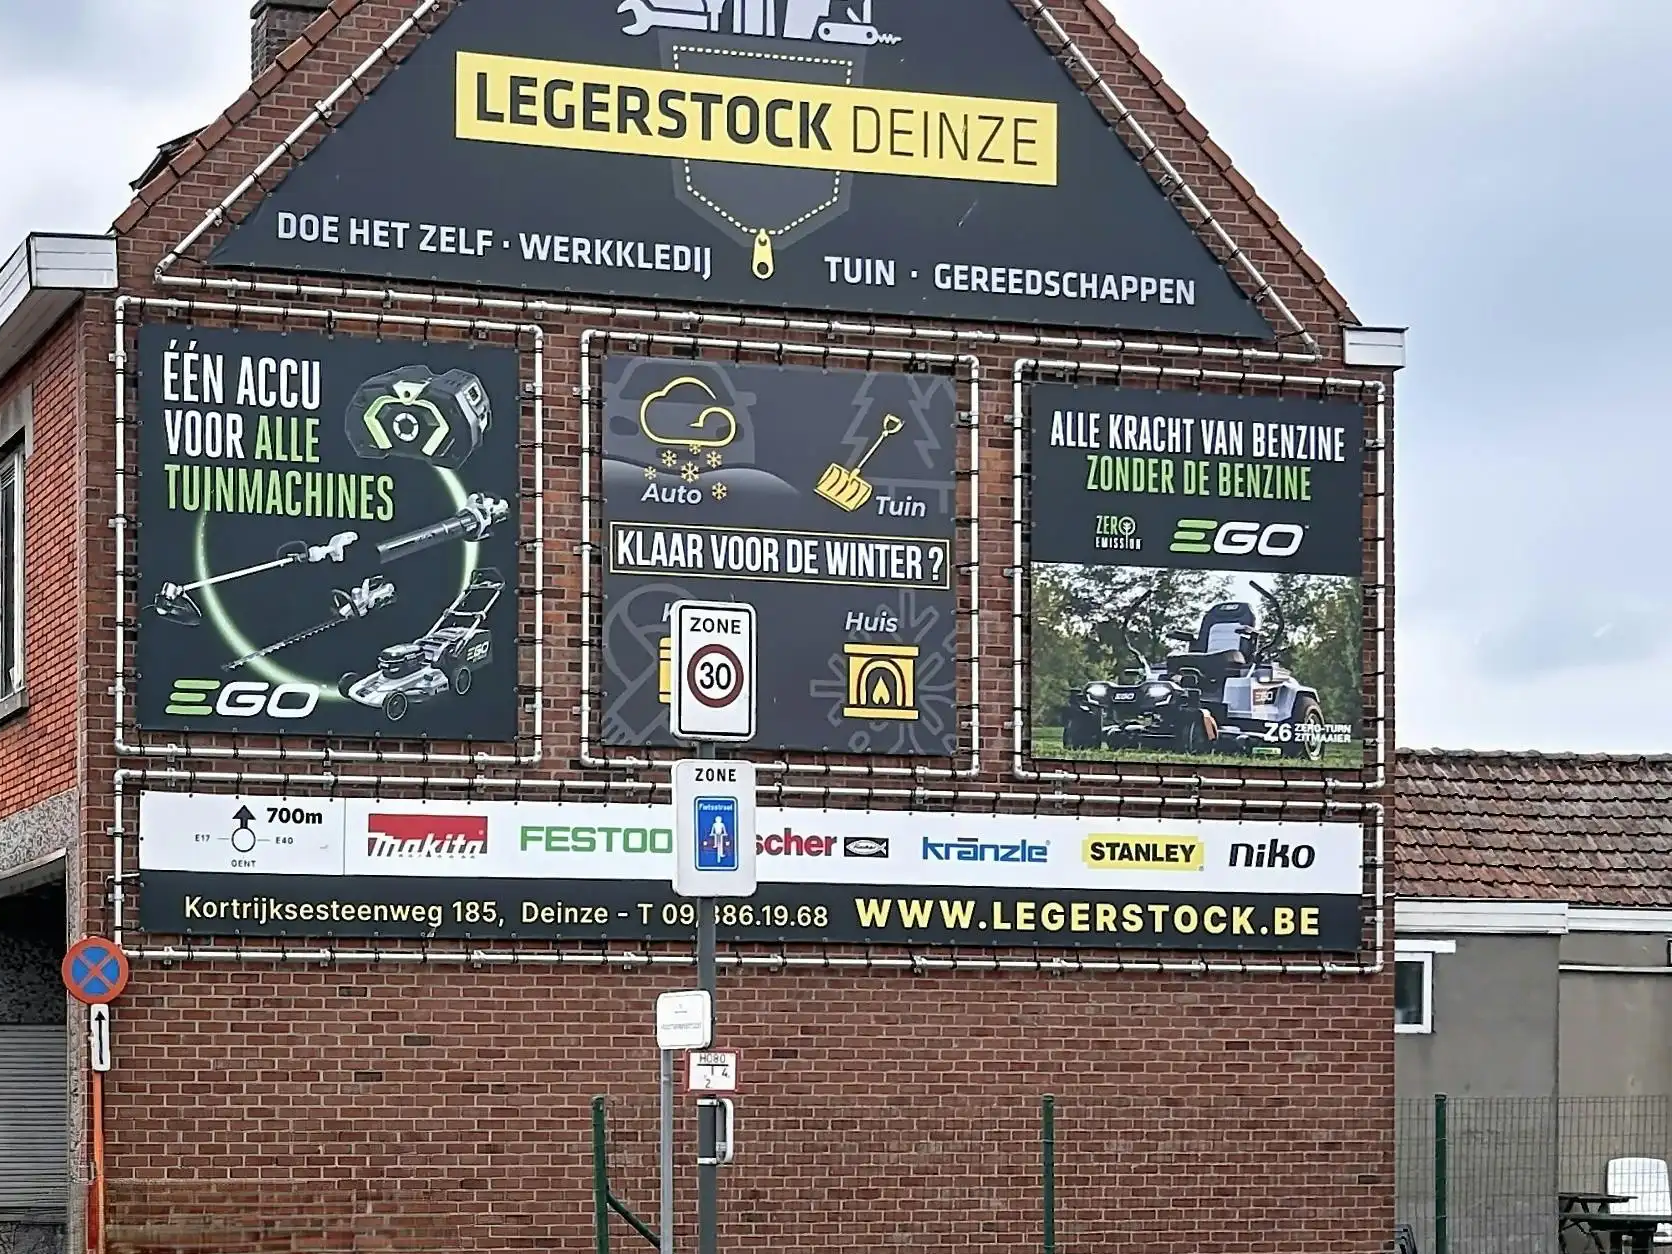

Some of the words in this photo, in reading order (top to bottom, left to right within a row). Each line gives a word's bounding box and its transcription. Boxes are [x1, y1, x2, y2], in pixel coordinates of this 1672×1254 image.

[475, 71, 833, 151] LEGERSTOCK
[852, 105, 1039, 166] DEINZE
[278, 211, 339, 244] DOE
[348, 218, 410, 249] HET
[418, 224, 494, 257] ZELF
[519, 232, 712, 280] WERKKLEDIJ
[824, 255, 896, 287] TUIN
[934, 263, 1196, 305] GEREEDSCHAPPEN
[163, 339, 224, 405] ÉÉN
[236, 356, 321, 410] ACCU
[164, 409, 245, 459] VOOR
[254, 415, 320, 463] ALLE
[1050, 410, 1100, 449] ALLE
[1108, 413, 1194, 454] KRACHT
[1201, 419, 1243, 458] VAN
[1253, 422, 1346, 462] BENZINE
[1086, 454, 1175, 494] ZONDER
[1183, 460, 1209, 496] DE
[1218, 463, 1311, 501] BENZINE
[164, 464, 395, 521] TUINMACHINES
[641, 483, 703, 505] Auto
[875, 495, 927, 518] Tuin
[1096, 515, 1136, 535] ZERO
[1169, 519, 1304, 556] EGO
[617, 530, 704, 569] KLAAR
[709, 535, 780, 573] VOOR
[786, 539, 819, 576] DE
[825, 541, 923, 580] WINTER
[690, 617, 741, 634] ZONE
[844, 611, 899, 634] Huis
[700, 662, 731, 690] 30
[165, 680, 320, 718] EGO
[1264, 722, 1292, 742] Z6
[1294, 723, 1352, 734] ZERO-TURN
[1294, 733, 1352, 743] ZITMAAIER
[695, 768, 737, 782] ZONE
[267, 807, 323, 824] 700m
[194, 834, 210, 842] E17
[368, 830, 486, 857] makita
[521, 826, 673, 853] FESTOO
[755, 828, 838, 856] scher
[1090, 841, 1196, 863] STANLEY
[1229, 840, 1316, 869] niko
[185, 896, 442, 927] Kortrijksesteenweg
[522, 902, 609, 925] Deinze
[638, 903, 650, 926] T
[662, 903, 828, 928] 0986.19.68
[854, 897, 1320, 936] WWW.LEGERSTOCK.BE
